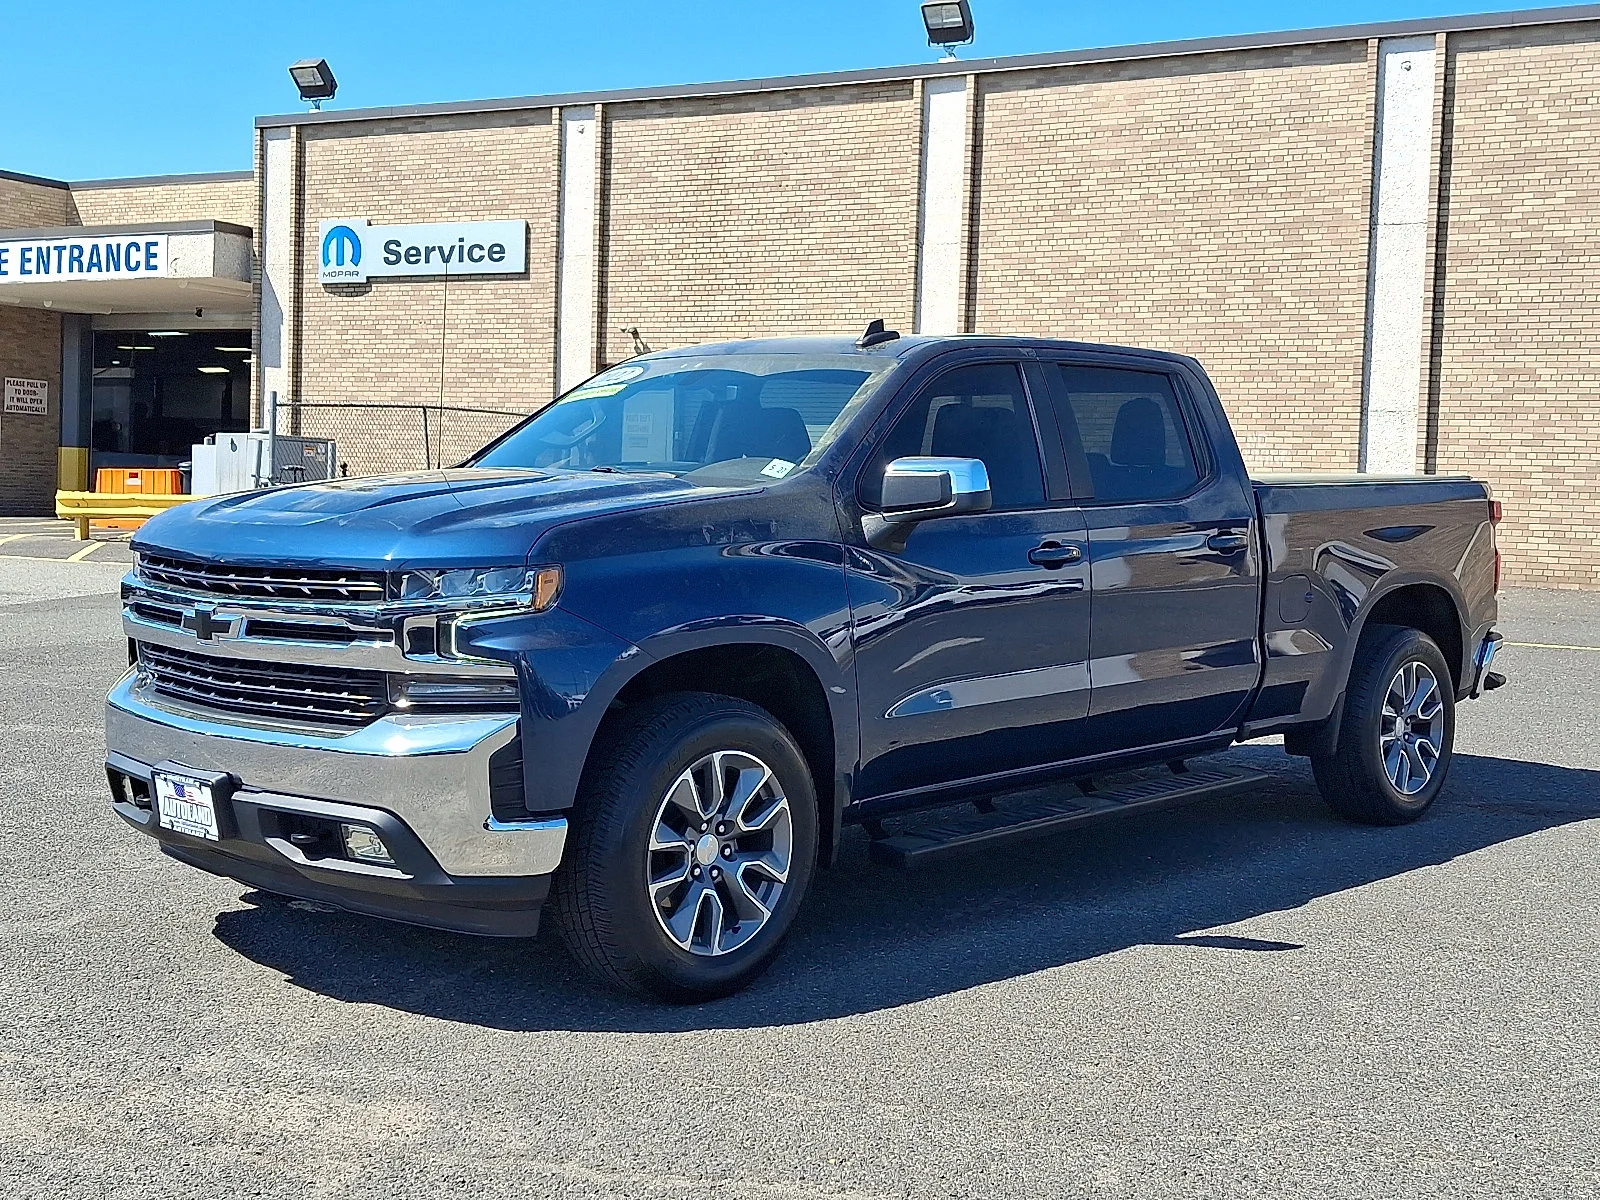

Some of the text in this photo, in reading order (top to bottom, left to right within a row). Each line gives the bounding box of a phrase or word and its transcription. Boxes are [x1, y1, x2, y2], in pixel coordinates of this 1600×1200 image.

[383, 237, 506, 266] Service
[20, 241, 159, 275] ENTRANCE
[322, 270, 360, 279] MOPAR
[6, 379, 25, 387] PLEASE
[6, 404, 46, 412] AUTOMATICALLY
